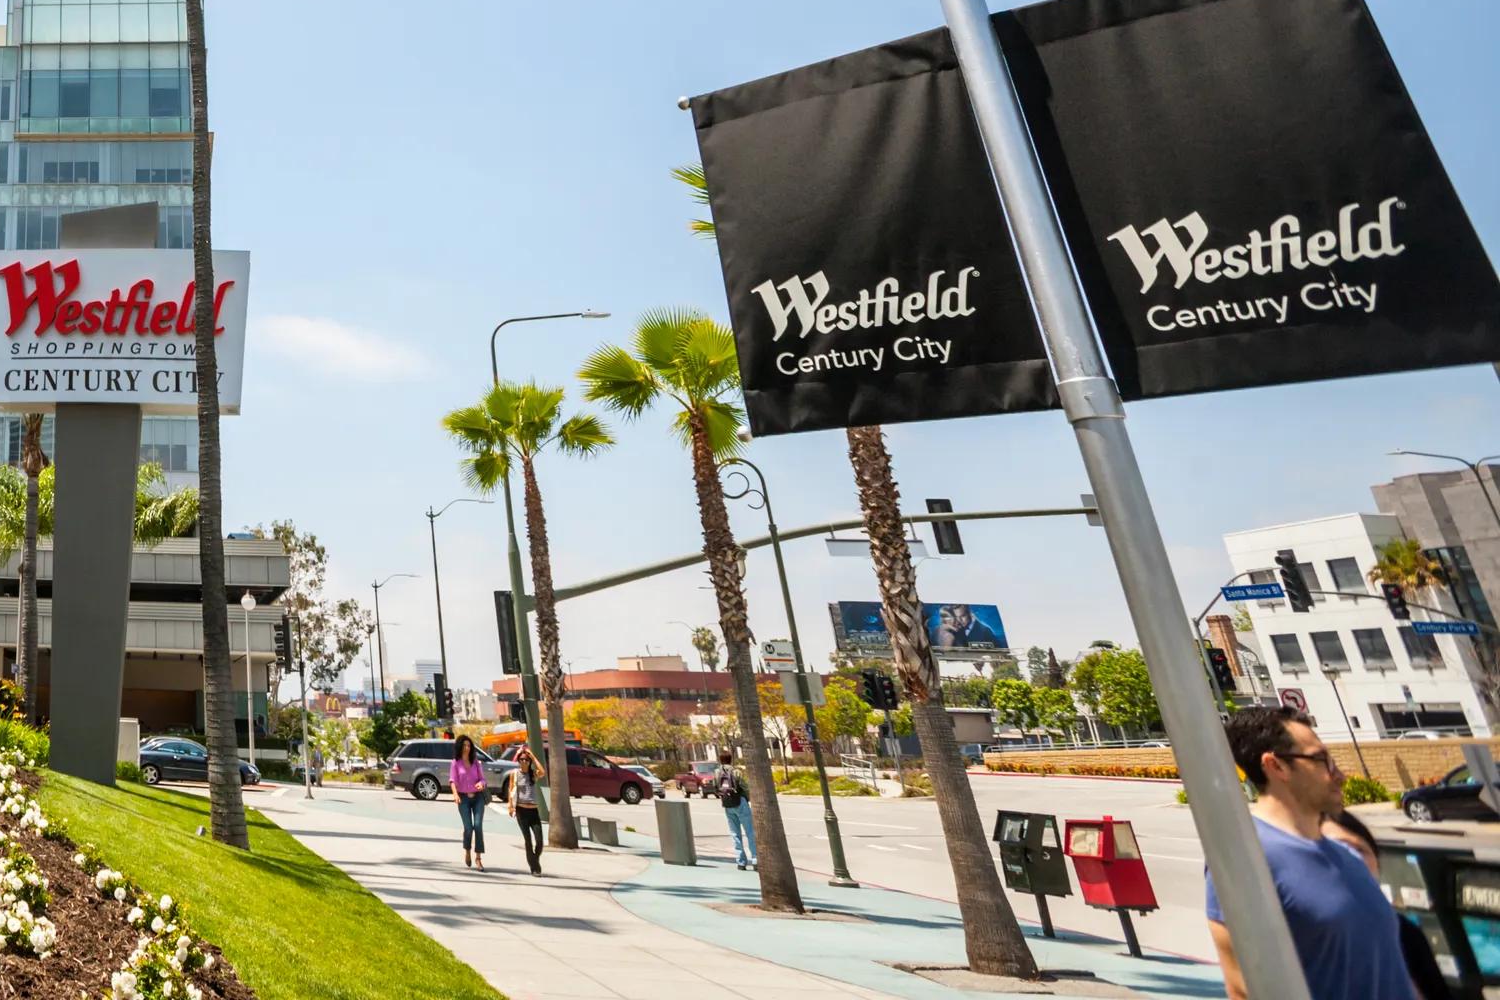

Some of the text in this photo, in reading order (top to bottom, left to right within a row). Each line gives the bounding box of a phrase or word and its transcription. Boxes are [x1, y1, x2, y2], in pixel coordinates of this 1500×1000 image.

[1105, 196, 1406, 295] Westfield
[750, 266, 977, 342] Westfield
[1146, 281, 1378, 332] Century City
[10, 341, 198, 356] SHOPPINGTOW
[776, 336, 952, 376] Century City
[3, 368, 143, 392] CENTURY
